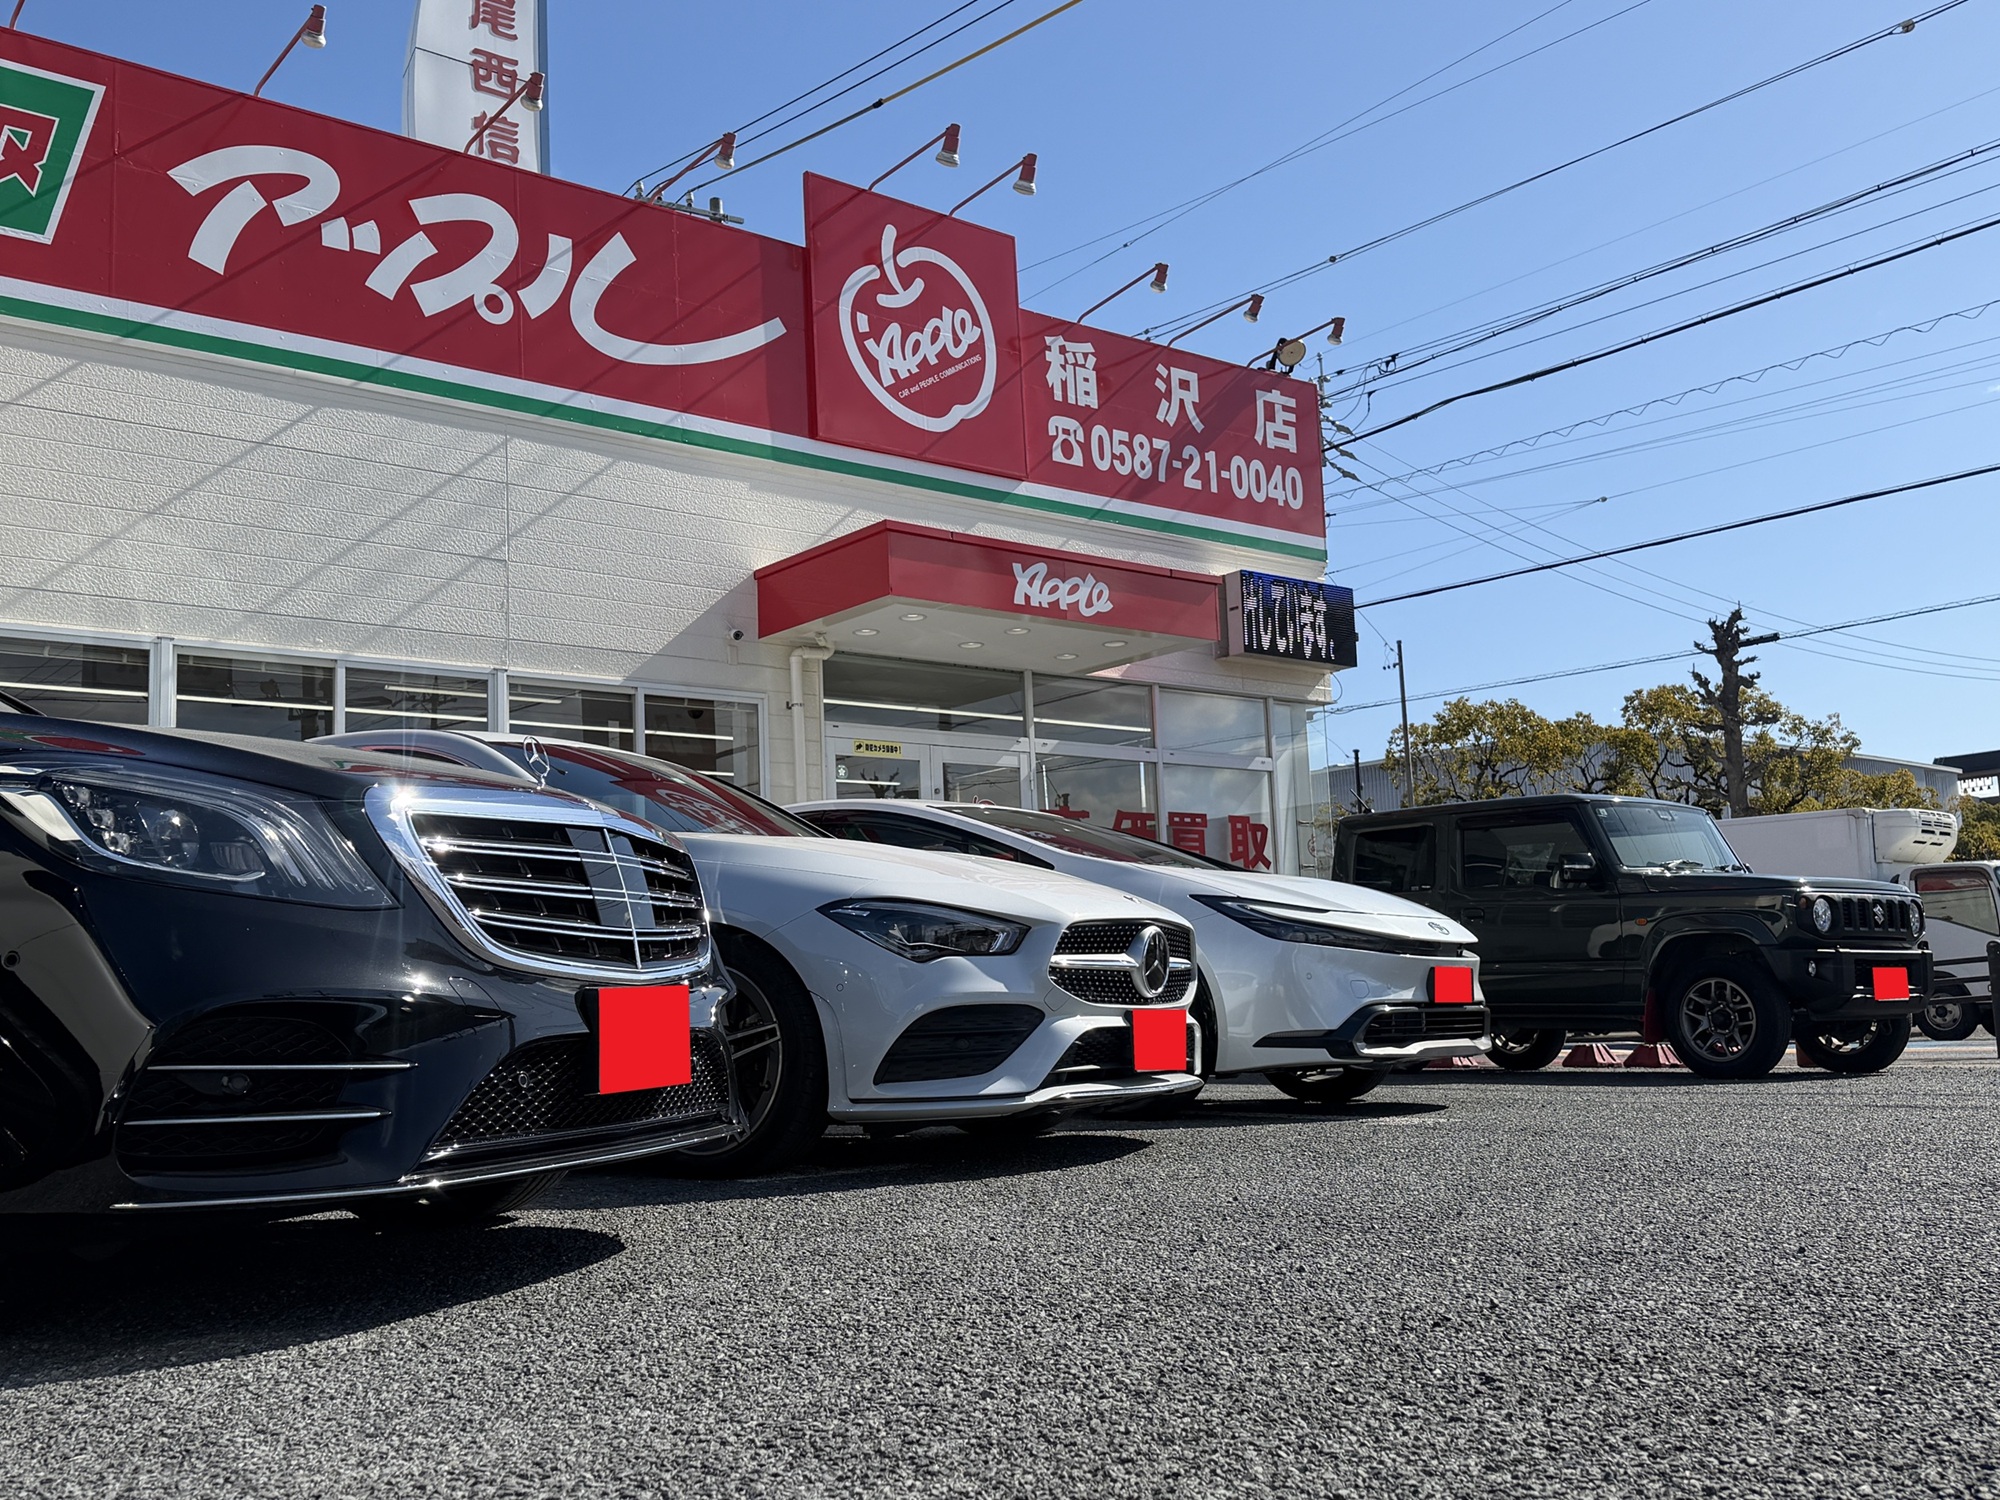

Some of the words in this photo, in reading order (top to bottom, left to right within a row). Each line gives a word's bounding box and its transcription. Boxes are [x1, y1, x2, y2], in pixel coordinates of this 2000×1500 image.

[167, 144, 787, 366] アップル
[898, 389, 910, 399] CAR
[920, 375, 939, 389] PEOPLE
[939, 354, 982, 379] COMMUNICATIONS
[1044, 335, 1297, 453] 稲沢店
[1091, 425, 1303, 510] 0587-21-0040
[1012, 562, 1114, 617] Apple
